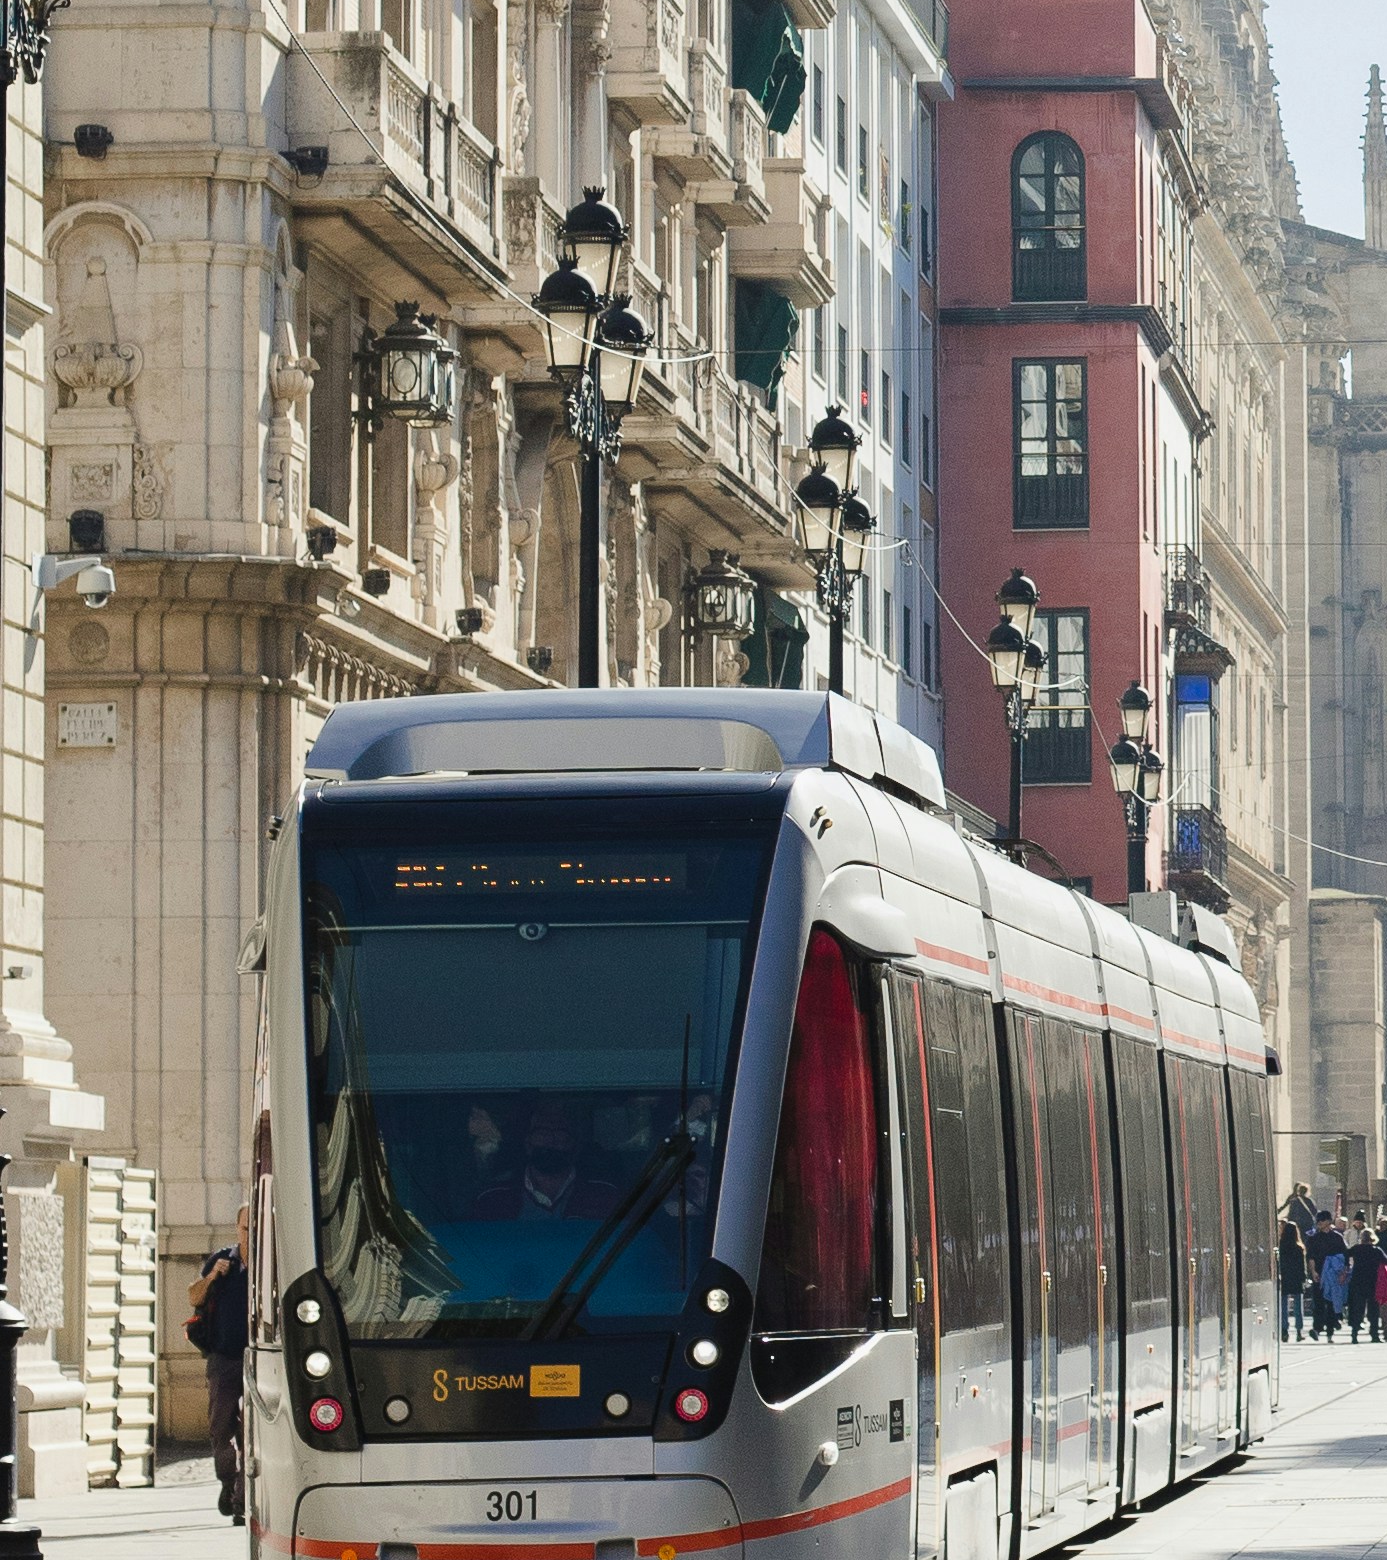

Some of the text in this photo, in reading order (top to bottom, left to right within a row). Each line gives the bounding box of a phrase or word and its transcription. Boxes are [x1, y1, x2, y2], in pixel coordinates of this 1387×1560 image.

[454, 1374, 524, 1392] TUSSAM
[864, 1414, 888, 1433] TUSSAM
[486, 1490, 537, 1522] 301
